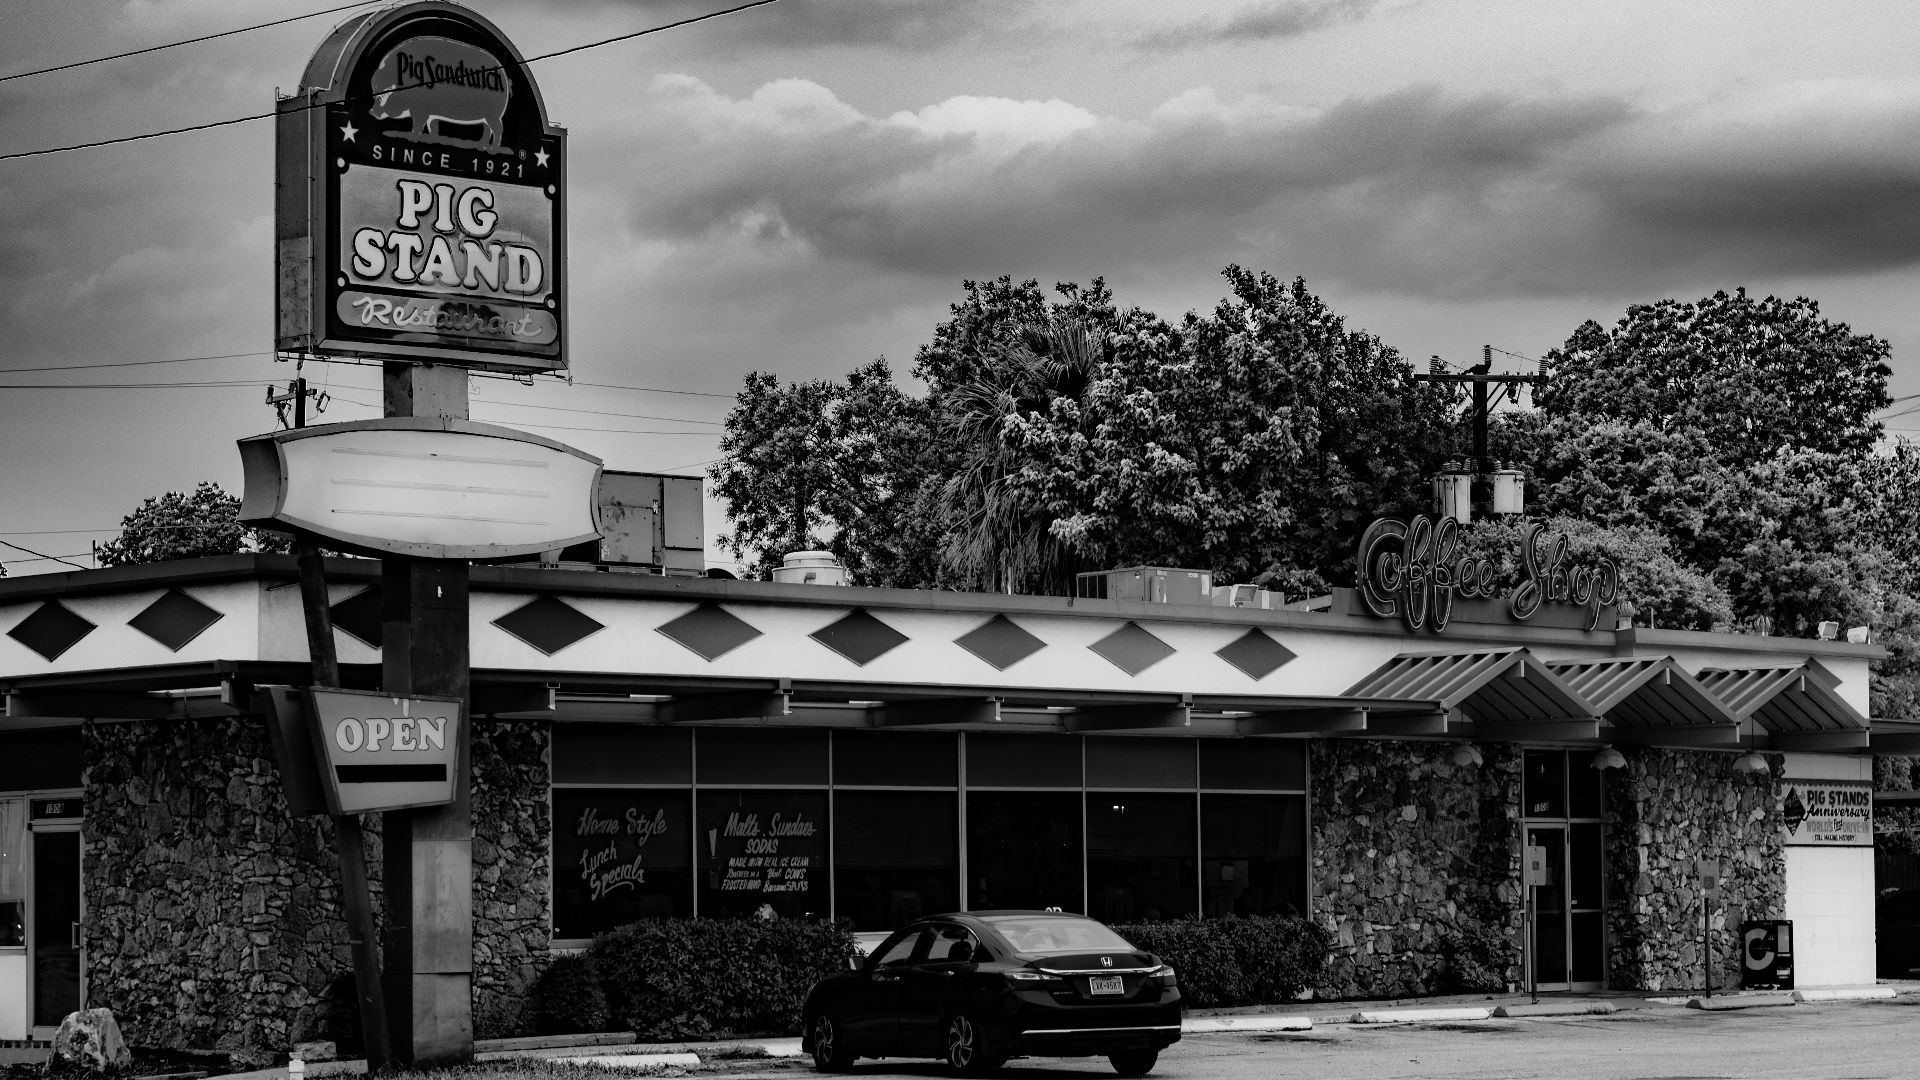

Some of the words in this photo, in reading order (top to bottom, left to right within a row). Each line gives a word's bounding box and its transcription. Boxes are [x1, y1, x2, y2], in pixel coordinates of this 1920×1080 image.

[397, 51, 424, 86] Pig
[423, 55, 505, 92] Sandwich
[372, 144, 450, 169] SINCE
[472, 158, 523, 178] 1921
[396, 178, 499, 239] PIG
[352, 226, 544, 296] STAND
[352, 296, 543, 337] Restaurant
[1357, 514, 1496, 632] Coffee
[1508, 522, 1618, 632] Shop
[335, 716, 447, 753] OPEN
[1802, 803, 1870, 821] Anniversary
[1807, 790, 1825, 805] PIG
[1828, 790, 1869, 806] STANDS
[577, 807, 620, 836] Home
[625, 807, 667, 847] Style
[769, 812, 818, 837] Sundaes
[579, 840, 618, 879] Lunch
[729, 857, 748, 867] MADE
[747, 857, 764, 867] WITH
[763, 857, 778, 867] REAL
[779, 857, 790, 867] ICE
[790, 857, 809, 867] CREAM
[745, 839, 779, 854] SODAS
[590, 854, 645, 901] Specials
[785, 868, 807, 879] COWS
